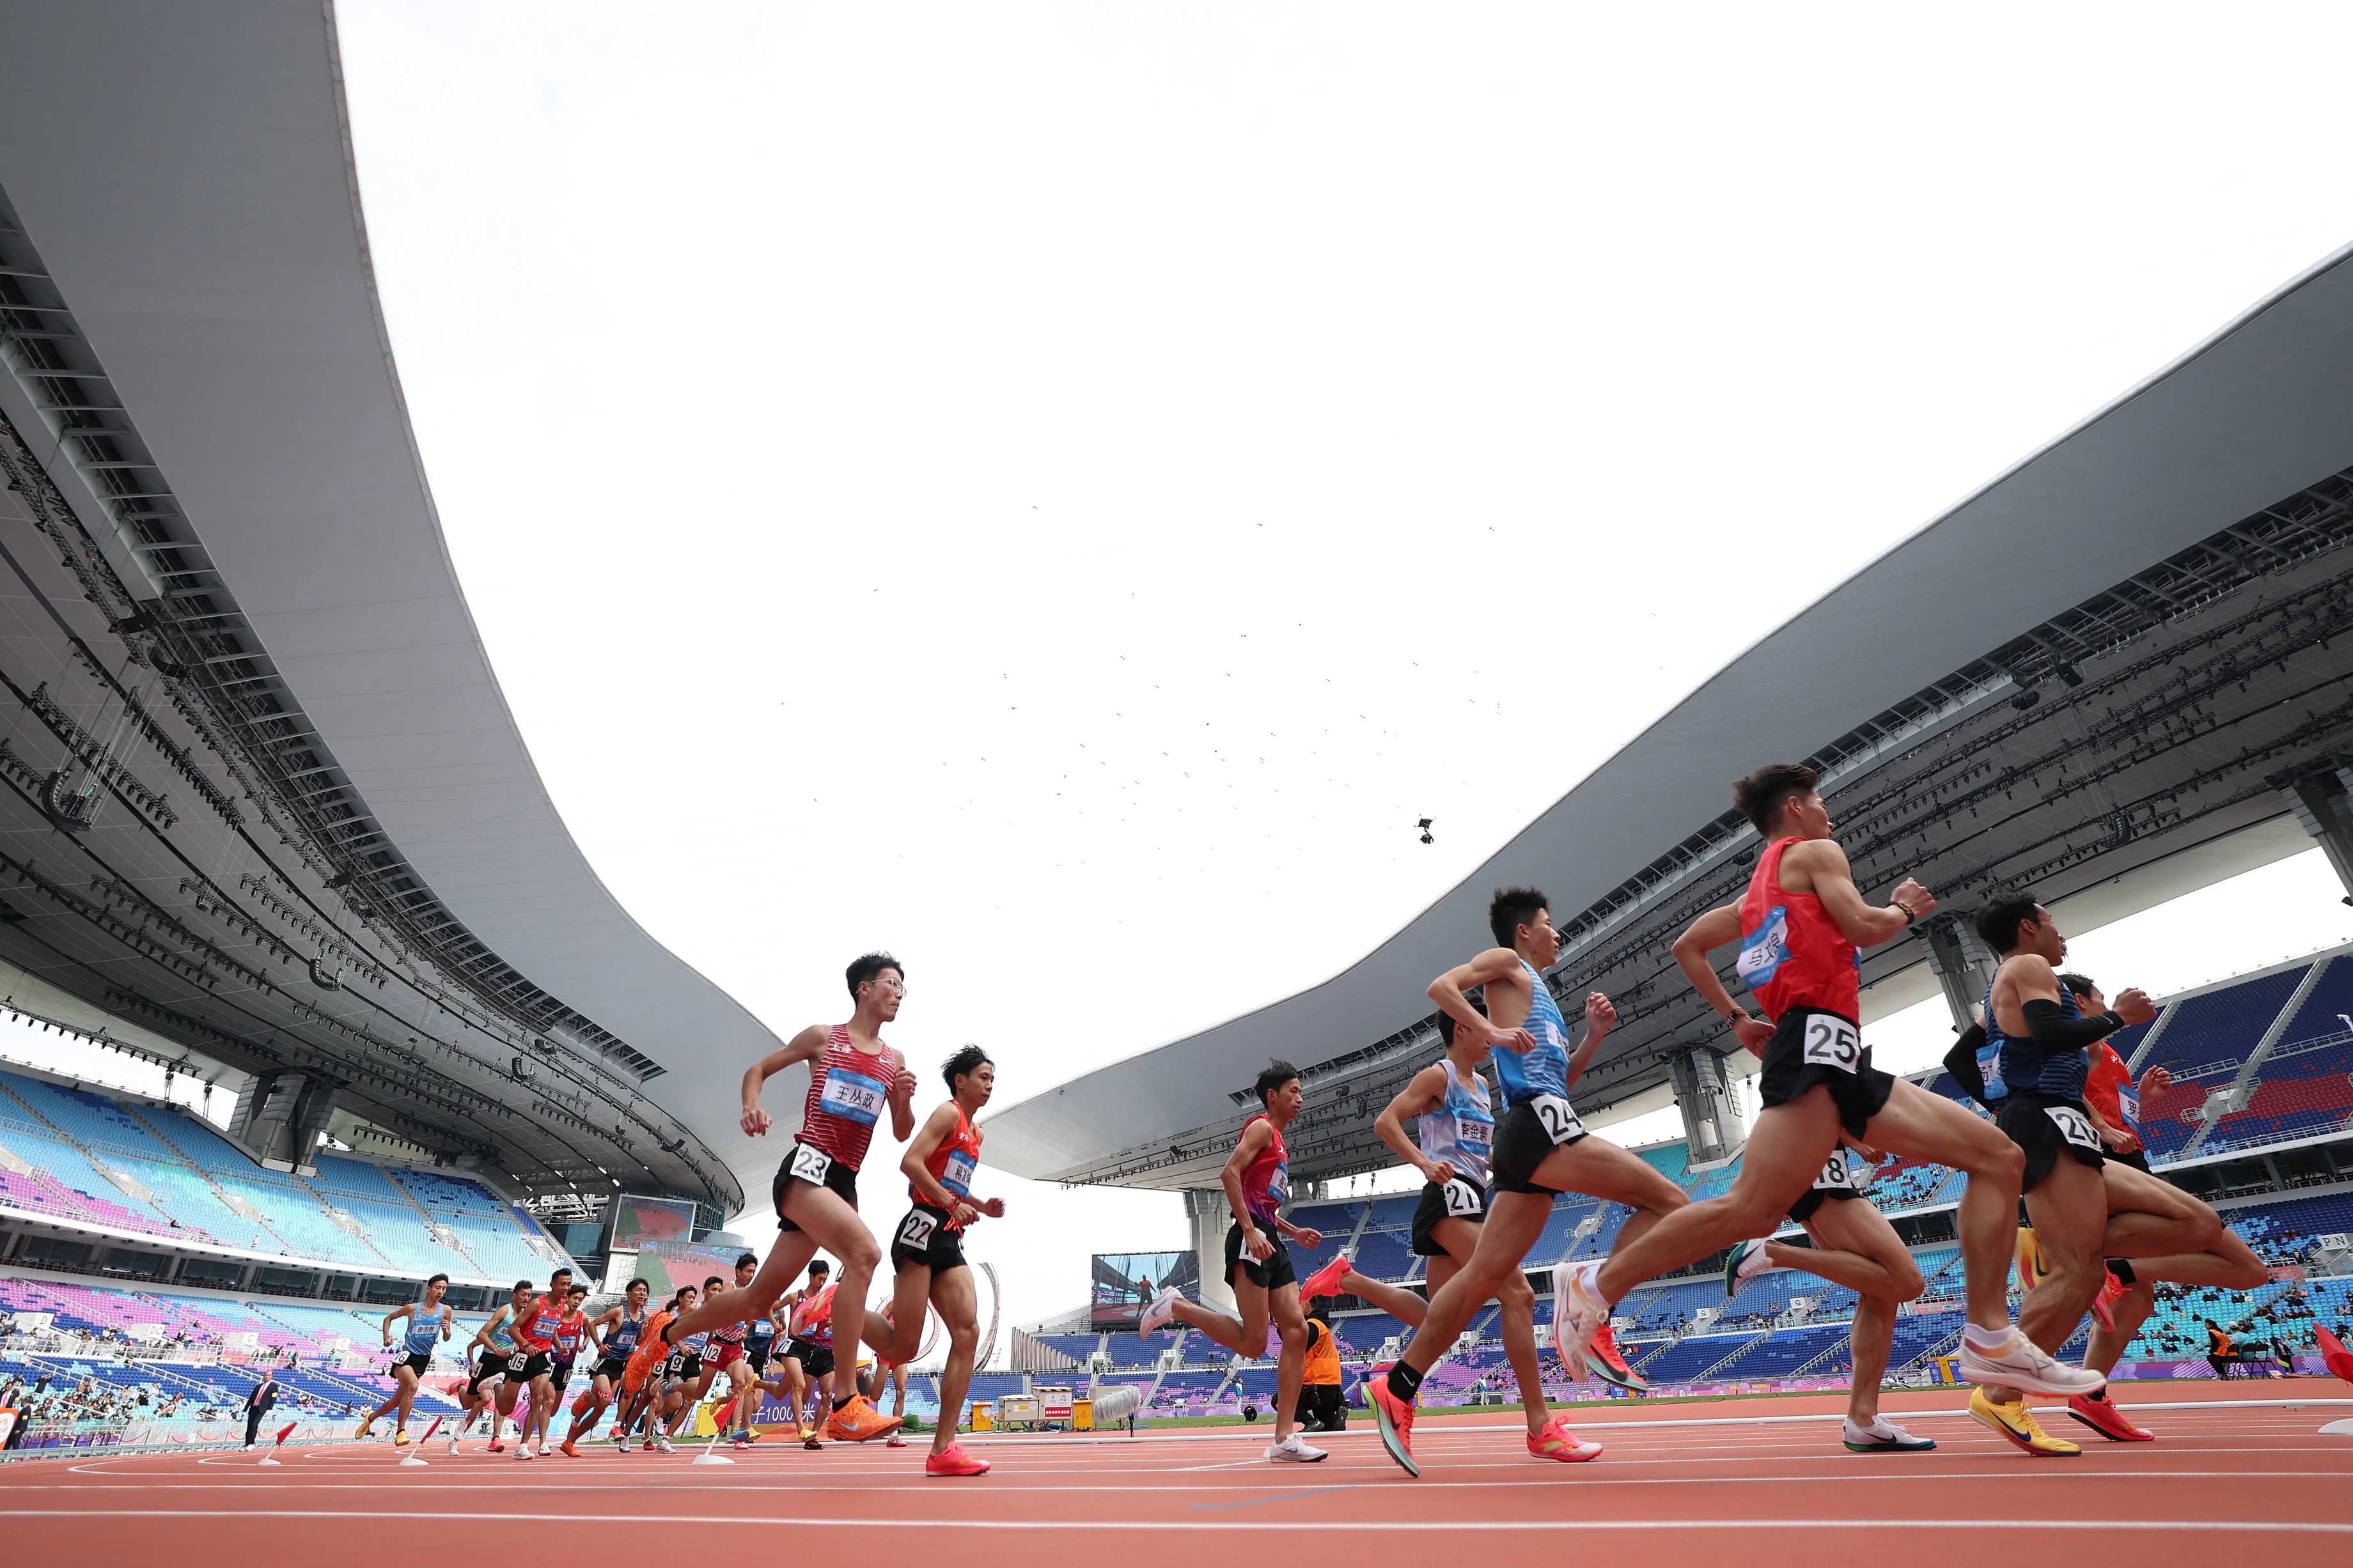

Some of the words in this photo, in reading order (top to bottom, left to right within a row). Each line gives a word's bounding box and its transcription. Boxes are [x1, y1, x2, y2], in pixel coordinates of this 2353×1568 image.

[831, 1043, 852, 1053] 上海
[1808, 1023, 1855, 1064] 25
[835, 1085, 875, 1110] 王丛政
[1540, 1101, 1582, 1138] 24
[2055, 1113, 2098, 1145] 20
[1461, 1122, 1489, 1141] 李金豪
[794, 1151, 826, 1179] 23
[1446, 1184, 1474, 1211] 21
[903, 1216, 932, 1246] 22
[2322, 1238, 2331, 1246] P
[2334, 1236, 2345, 1245] N
[40, 1316, 47, 1324] D
[394, 1353, 407, 1362] 16
[512, 1356, 525, 1369] 15
[673, 1357, 681, 1369] 9
[707, 1347, 719, 1360] 12
